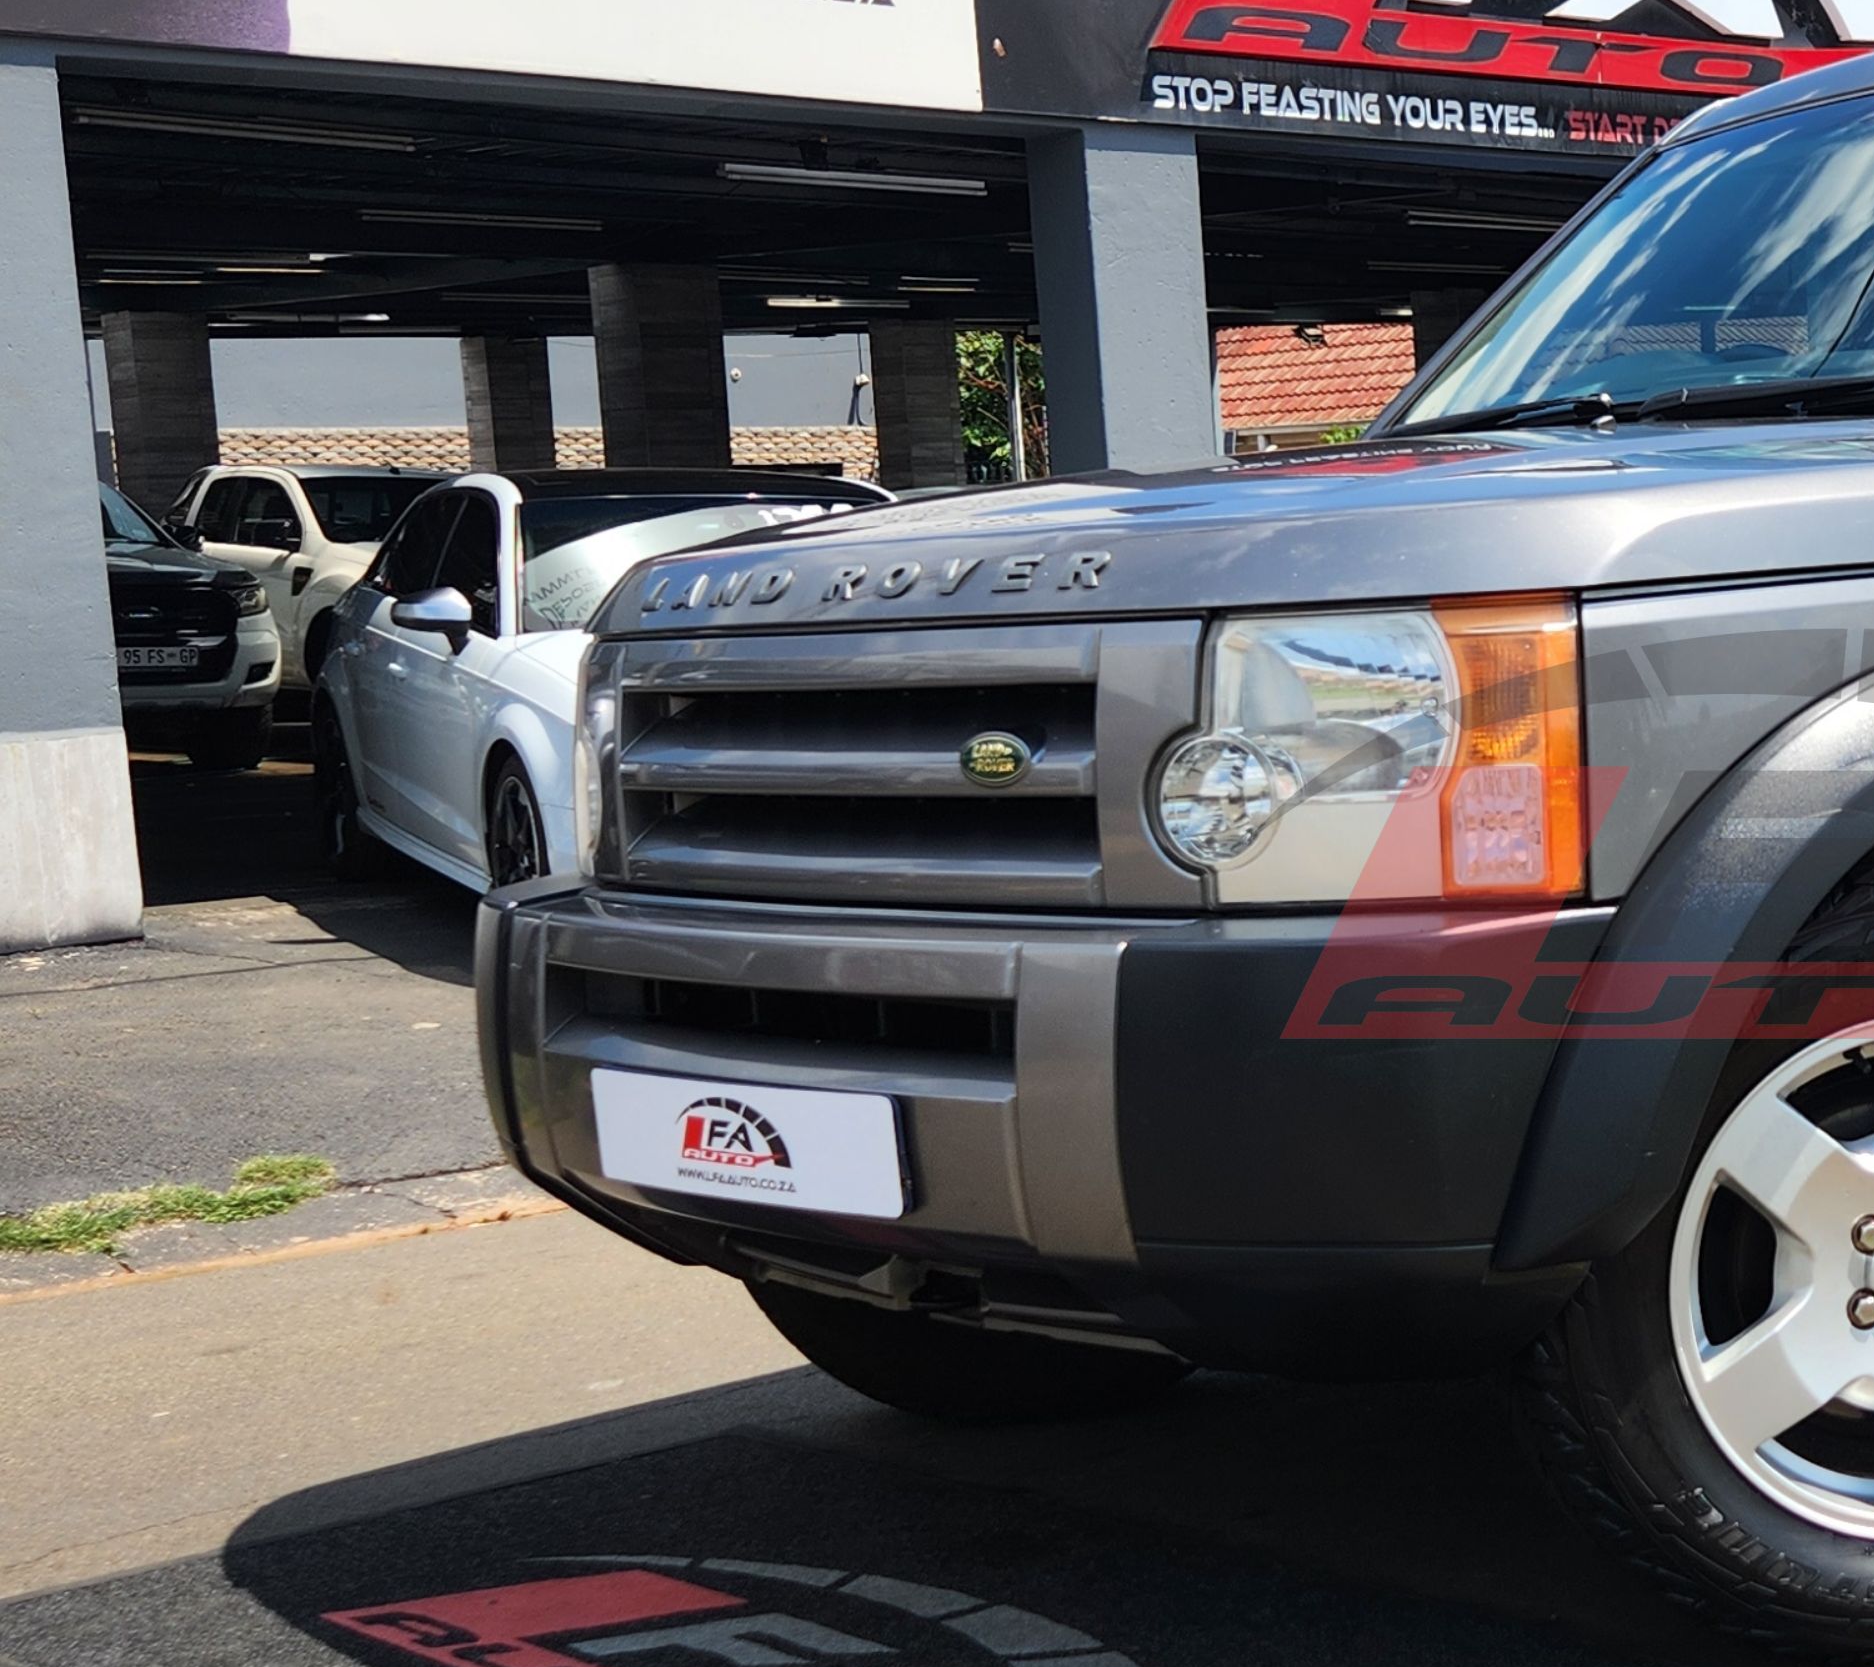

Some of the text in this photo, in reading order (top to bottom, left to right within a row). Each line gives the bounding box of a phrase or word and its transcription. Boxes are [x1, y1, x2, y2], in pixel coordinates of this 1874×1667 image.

[1183, 7, 1785, 86] AUTO
[1152, 74, 1234, 113] STOP
[1241, 82, 1382, 125] FEASTING
[1386, 94, 1465, 133] YOUR
[1469, 101, 1556, 139] EYES...
[1568, 110, 1647, 144] START
[640, 567, 796, 612] LAND
[821, 550, 1113, 602] ROVER
[148, 649, 165, 664] FS
[180, 648, 197, 663] GP
[683, 1147, 756, 1167] AUTO
